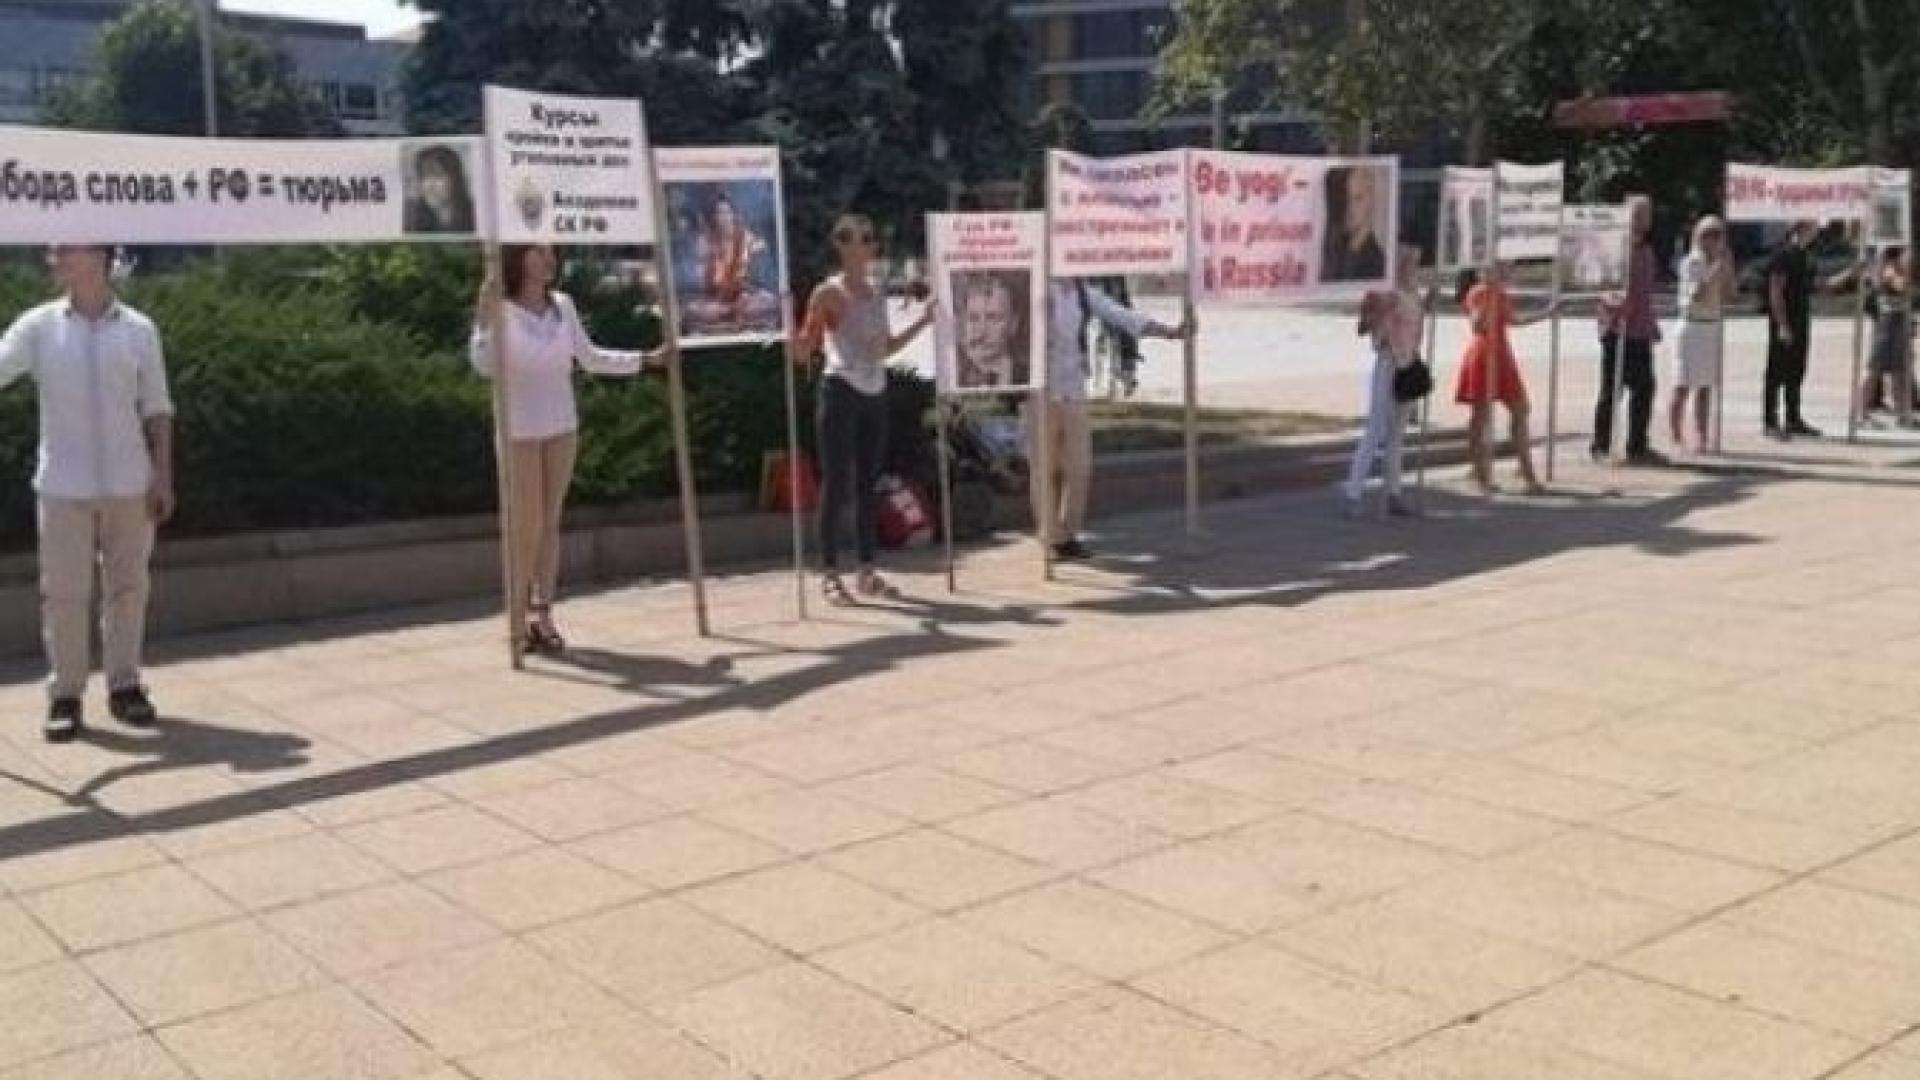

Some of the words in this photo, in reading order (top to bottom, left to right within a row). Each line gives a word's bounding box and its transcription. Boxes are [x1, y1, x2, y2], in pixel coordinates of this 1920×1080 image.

[0, 160, 77, 209] бода
[85, 168, 174, 202] слова
[208, 167, 249, 202] РФ
[281, 173, 386, 212] тюрьма
[1196, 160, 1230, 195] Be
[554, 214, 578, 233] СК
[581, 215, 609, 233] РФ
[1245, 220, 1313, 248] prison
[1220, 254, 1307, 289] Russia
